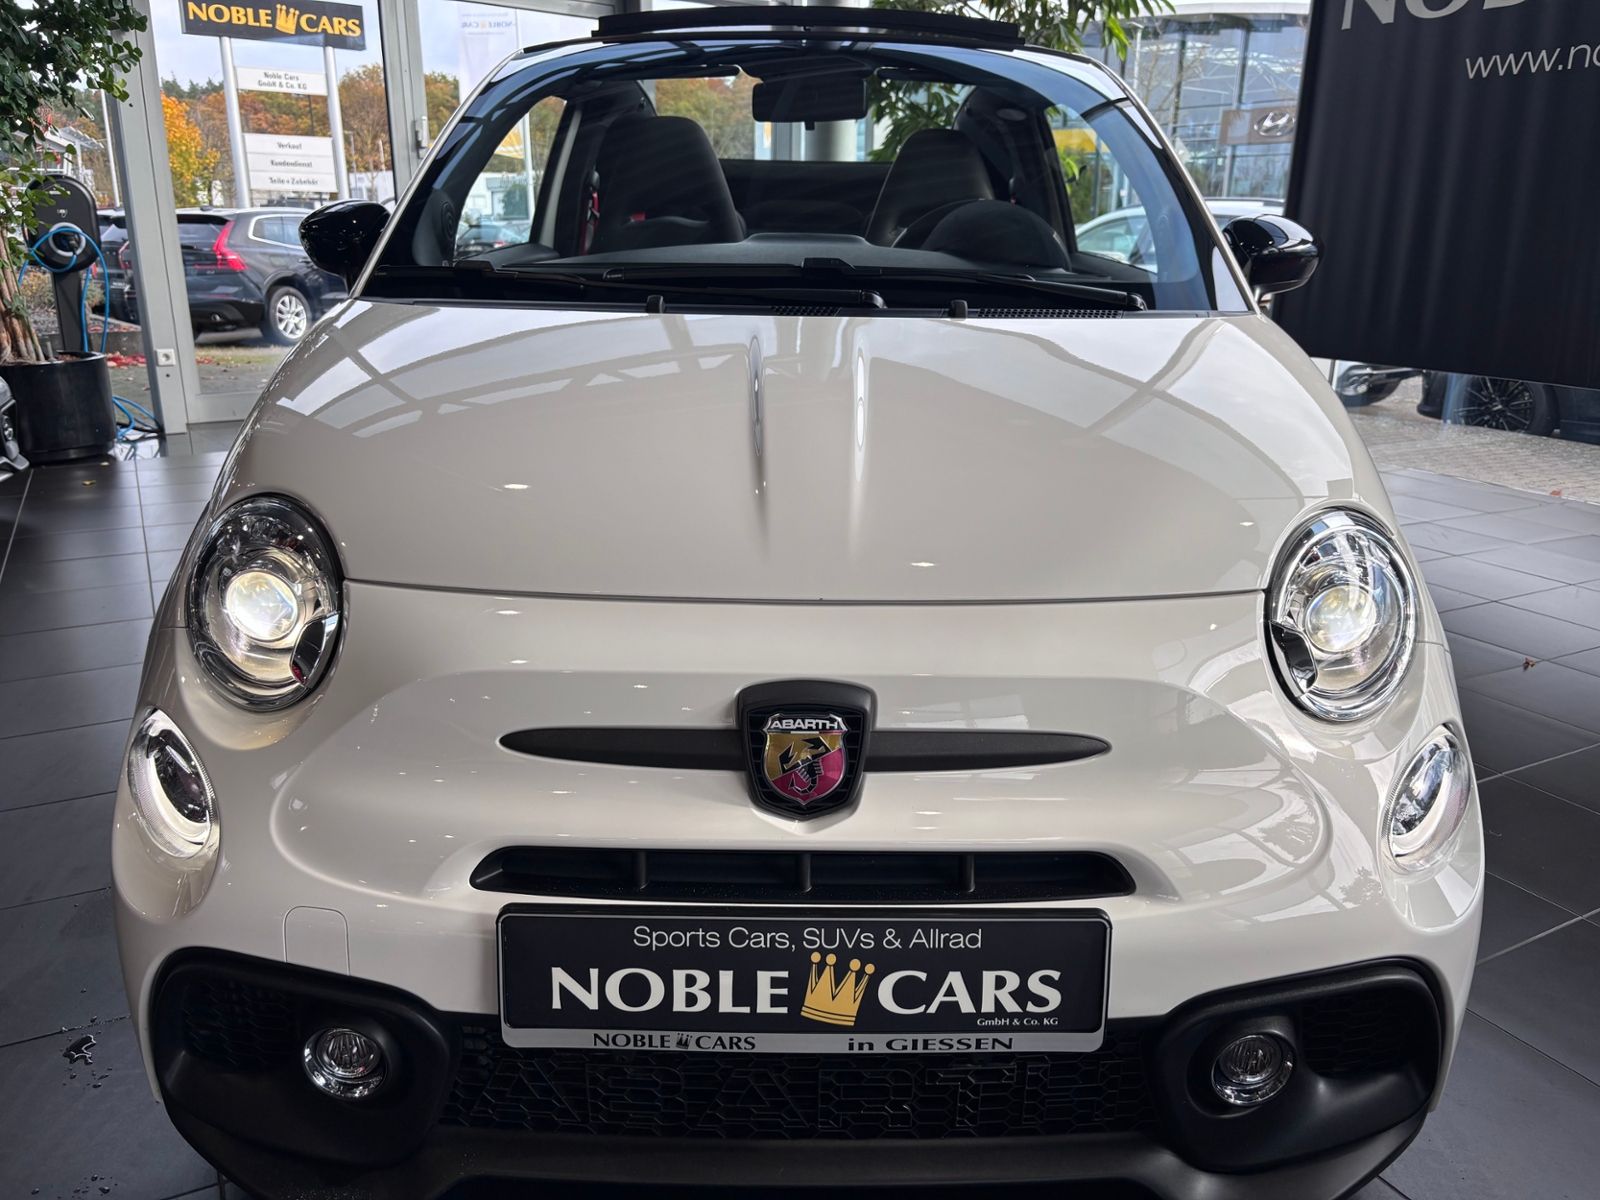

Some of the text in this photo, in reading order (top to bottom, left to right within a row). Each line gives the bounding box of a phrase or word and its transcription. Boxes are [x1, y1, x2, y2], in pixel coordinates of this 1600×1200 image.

[187, 2, 362, 37] NOBLE CARS
[770, 718, 837, 730] ABARTH
[633, 926, 982, 951] Sports Cars, SUVs & Allrad
[551, 967, 1063, 1015] NOBLE CARS
[977, 1017, 1059, 1026] GmbH & Co. KG
[593, 1033, 756, 1051] NOBLE CARS
[848, 1036, 1013, 1051] in GIESSEN
